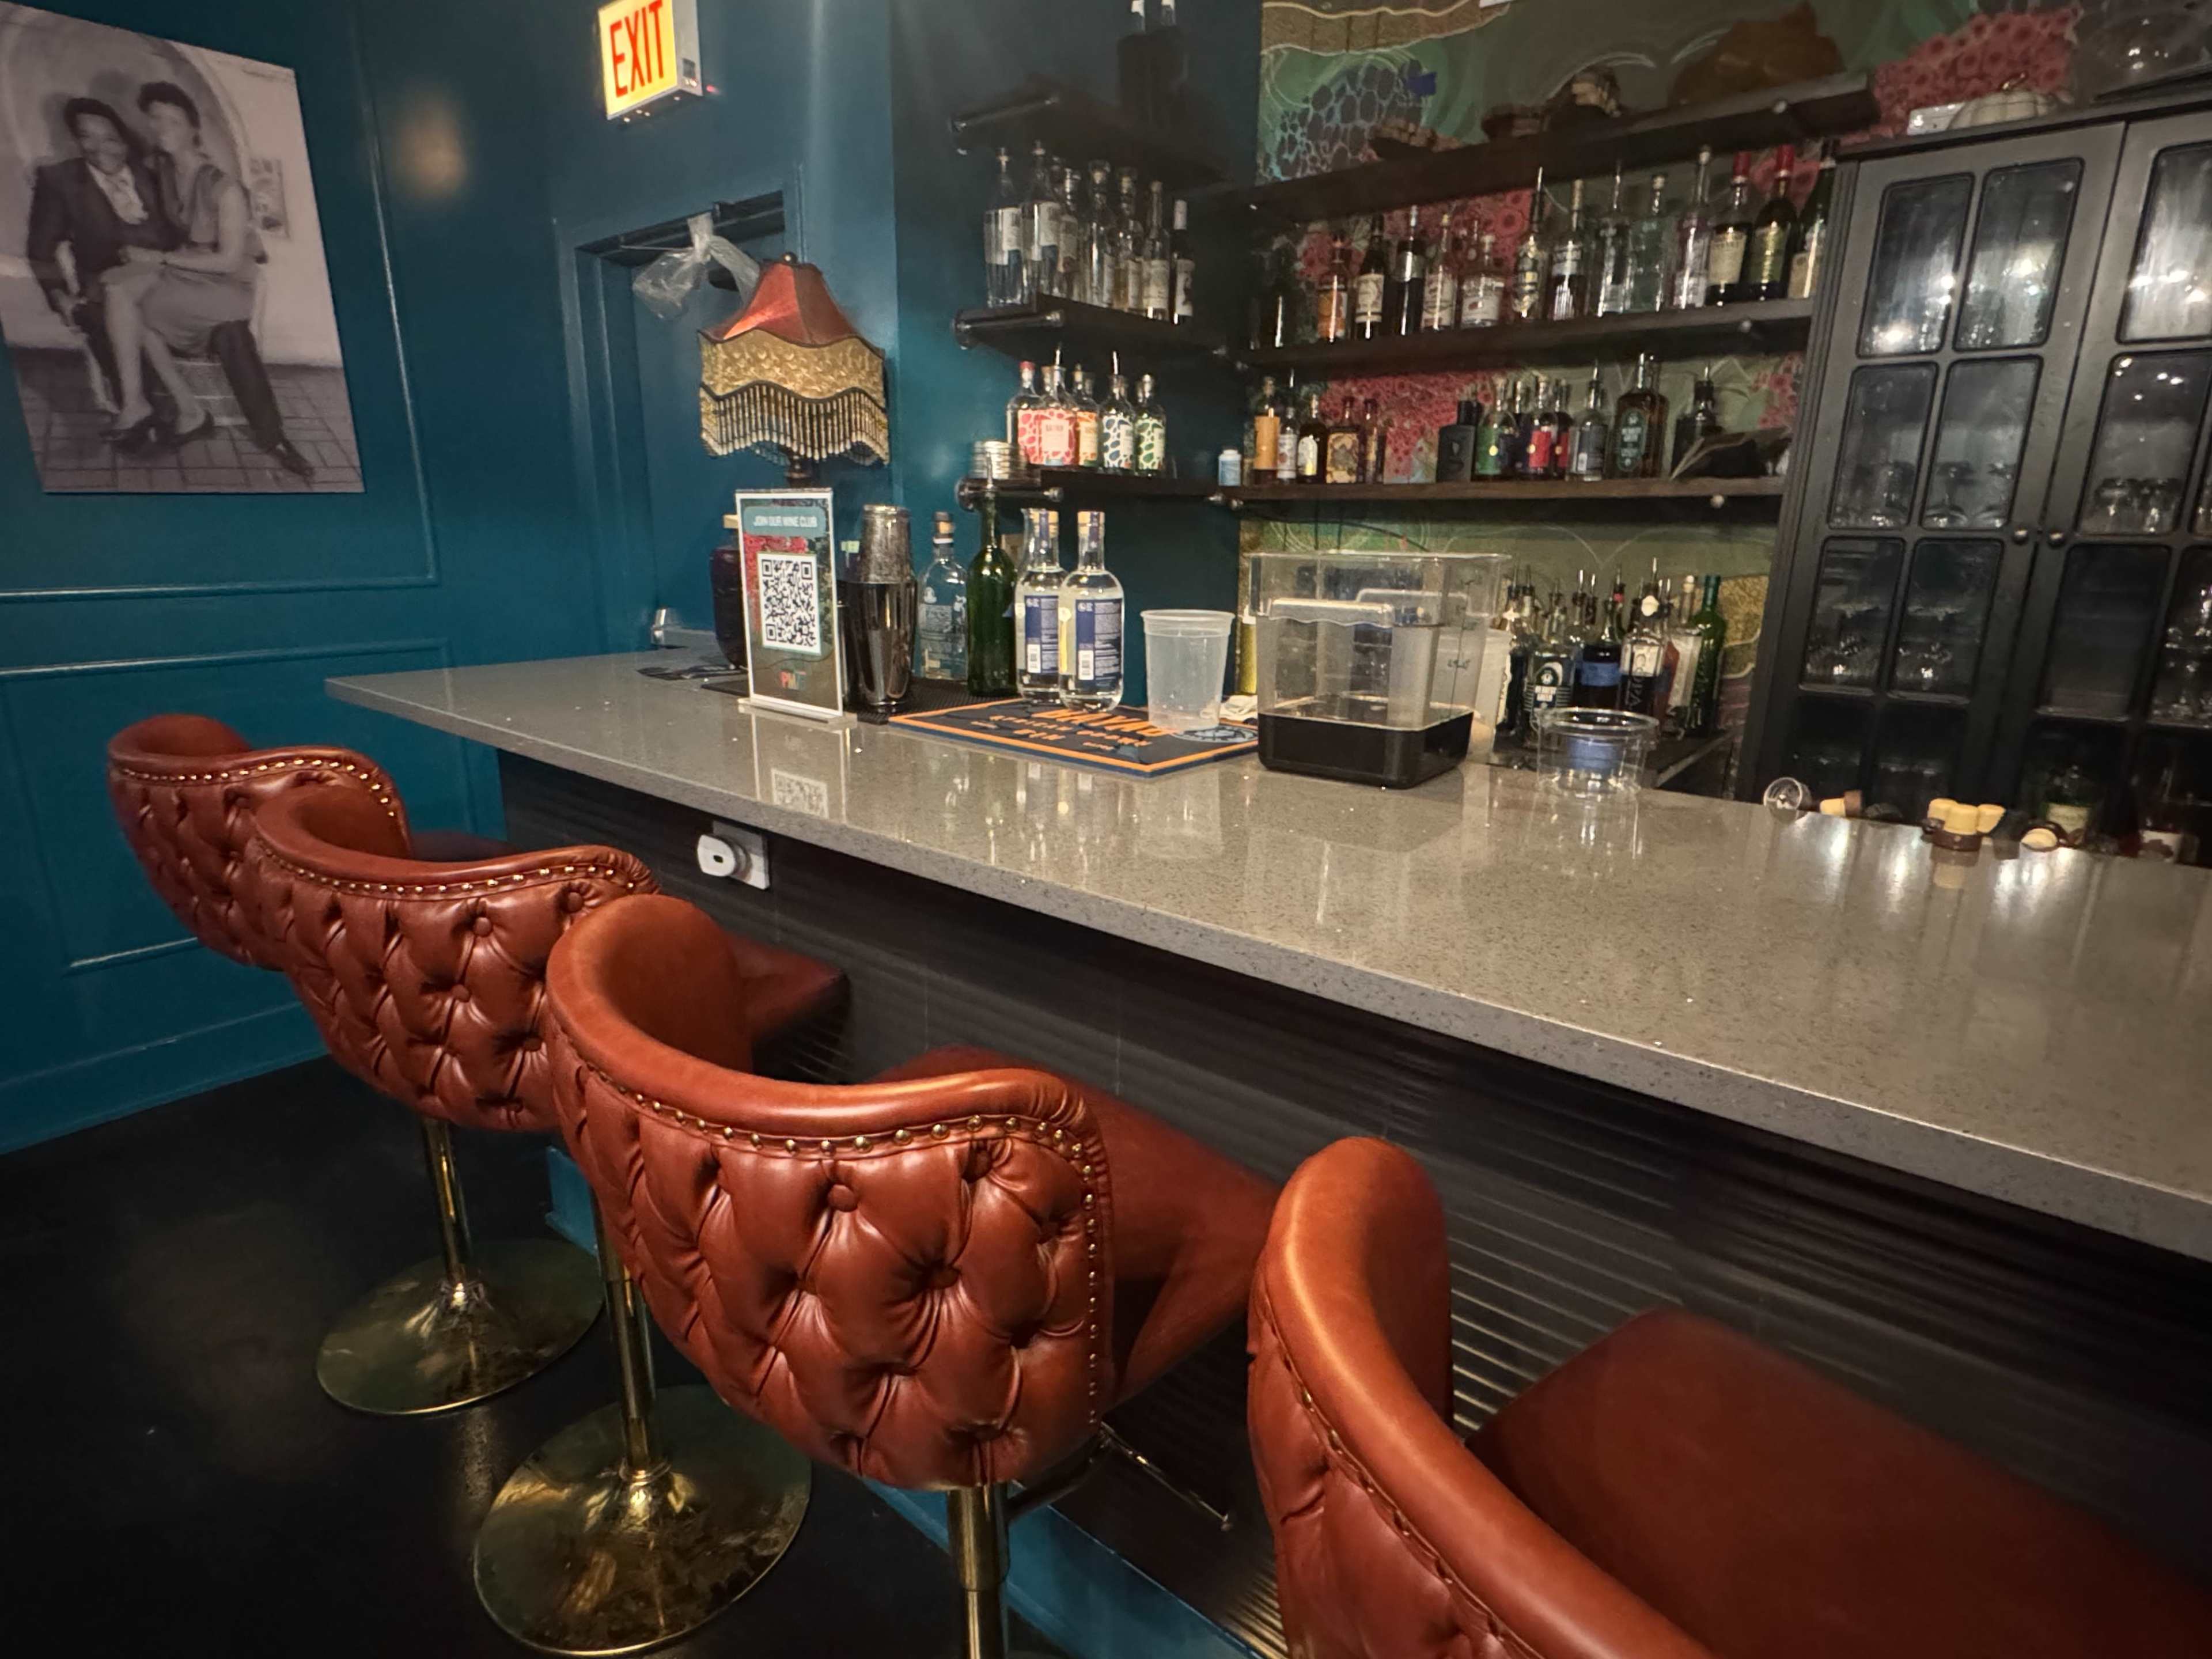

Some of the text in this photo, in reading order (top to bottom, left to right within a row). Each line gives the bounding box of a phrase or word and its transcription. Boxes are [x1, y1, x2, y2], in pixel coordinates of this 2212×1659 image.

[609, 0, 664, 97] EXIT
[753, 516, 817, 528] JOIN OUR WINE CLUB
